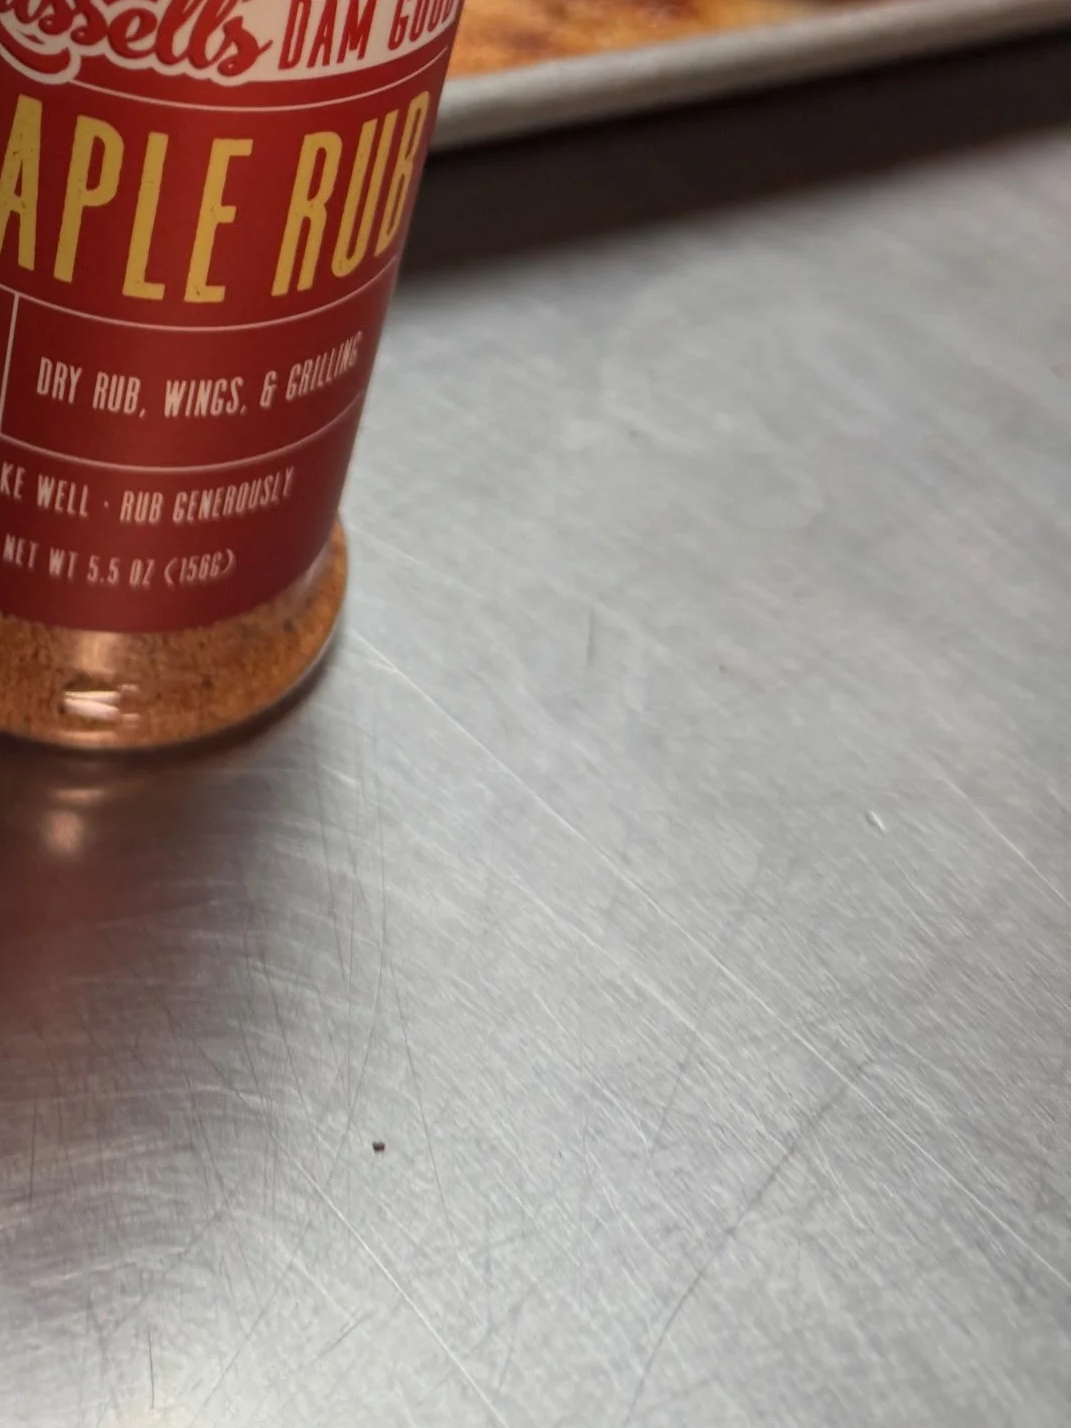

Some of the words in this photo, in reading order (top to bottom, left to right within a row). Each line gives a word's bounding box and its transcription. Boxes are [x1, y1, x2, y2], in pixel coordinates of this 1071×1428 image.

[271, 90, 431, 297] RUB
[36, 356, 83, 404] DRY
[92, 373, 146, 419] RUB,
[163, 375, 248, 418] WINGS,
[260, 370, 278, 409] &
[285, 329, 363, 402] GRILLING
[36, 468, 89, 518] WELL
[119, 490, 162, 524] RUB
[172, 466, 295, 523] GENEROUSLY
[2, 533, 38, 570] NET
[48, 548, 79, 581] WT
[87, 554, 119, 584] 5.5
[130, 555, 155, 588] OZ
